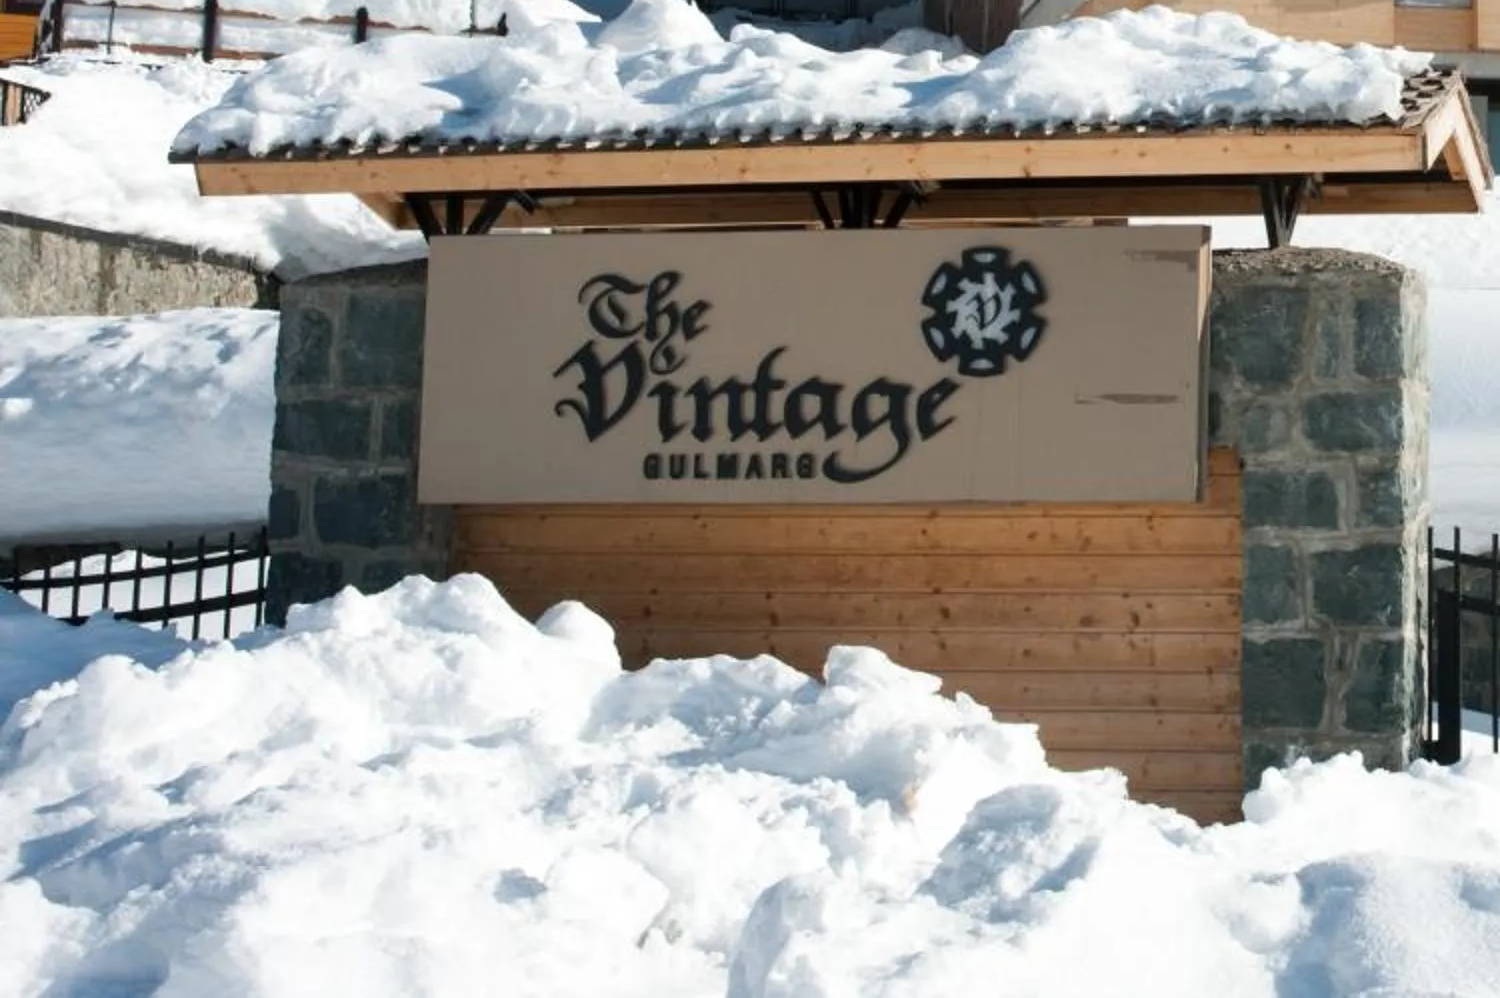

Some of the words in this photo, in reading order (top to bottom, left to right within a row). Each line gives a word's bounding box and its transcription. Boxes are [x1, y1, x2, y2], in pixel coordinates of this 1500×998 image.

[578, 270, 712, 375] The
[553, 340, 961, 482] Vintage
[643, 453, 815, 480] GULMARG
